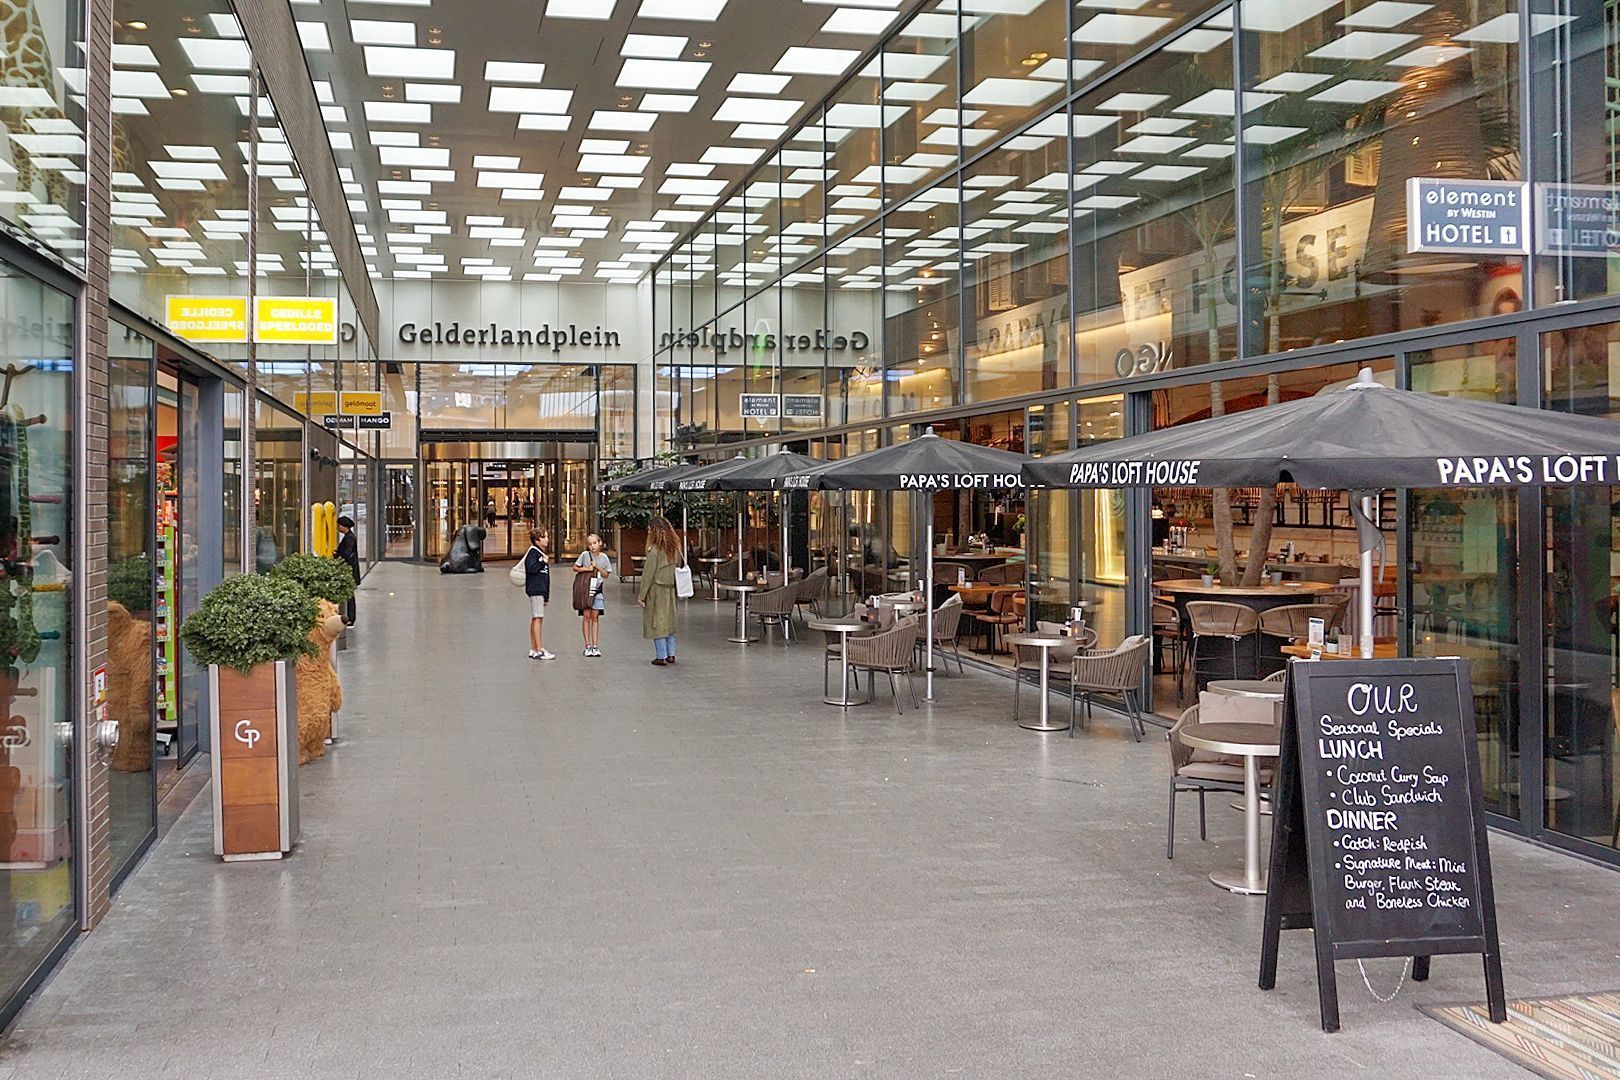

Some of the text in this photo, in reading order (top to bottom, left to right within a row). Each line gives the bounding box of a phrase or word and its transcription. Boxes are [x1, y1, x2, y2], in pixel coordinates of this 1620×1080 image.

[1426, 187, 1516, 206] element
[1447, 209, 1460, 218] BY
[1426, 223, 1494, 244] HOTEL
[270, 308, 323, 320] CEDILLE
[259, 321, 333, 333] SPEELGOED
[398, 323, 621, 352] Gelderlandplein
[1069, 461, 1201, 485] PAPA'S LOFT HOUSE
[1437, 456, 1534, 484] PAPA'S
[1542, 455, 1607, 483] LOFT
[900, 474, 1046, 489] PAPA'S LOFT HOU
[1347, 683, 1418, 715] OUR
[1320, 715, 1443, 741] Seasonal Specials
[1319, 739, 1383, 760] LUNCH
[1337, 765, 1387, 785] Coconut
[1423, 765, 1449, 787] Soup
[1342, 785, 1443, 806] Club Sandwich
[1326, 808, 1398, 830] DINNER
[1382, 835, 1428, 854] Redfish
[1439, 858, 1466, 873] Mini
[1388, 876, 1422, 893] Flank
[1425, 876, 1461, 892] Steak
[1345, 892, 1471, 910] and Boneless Chicken
